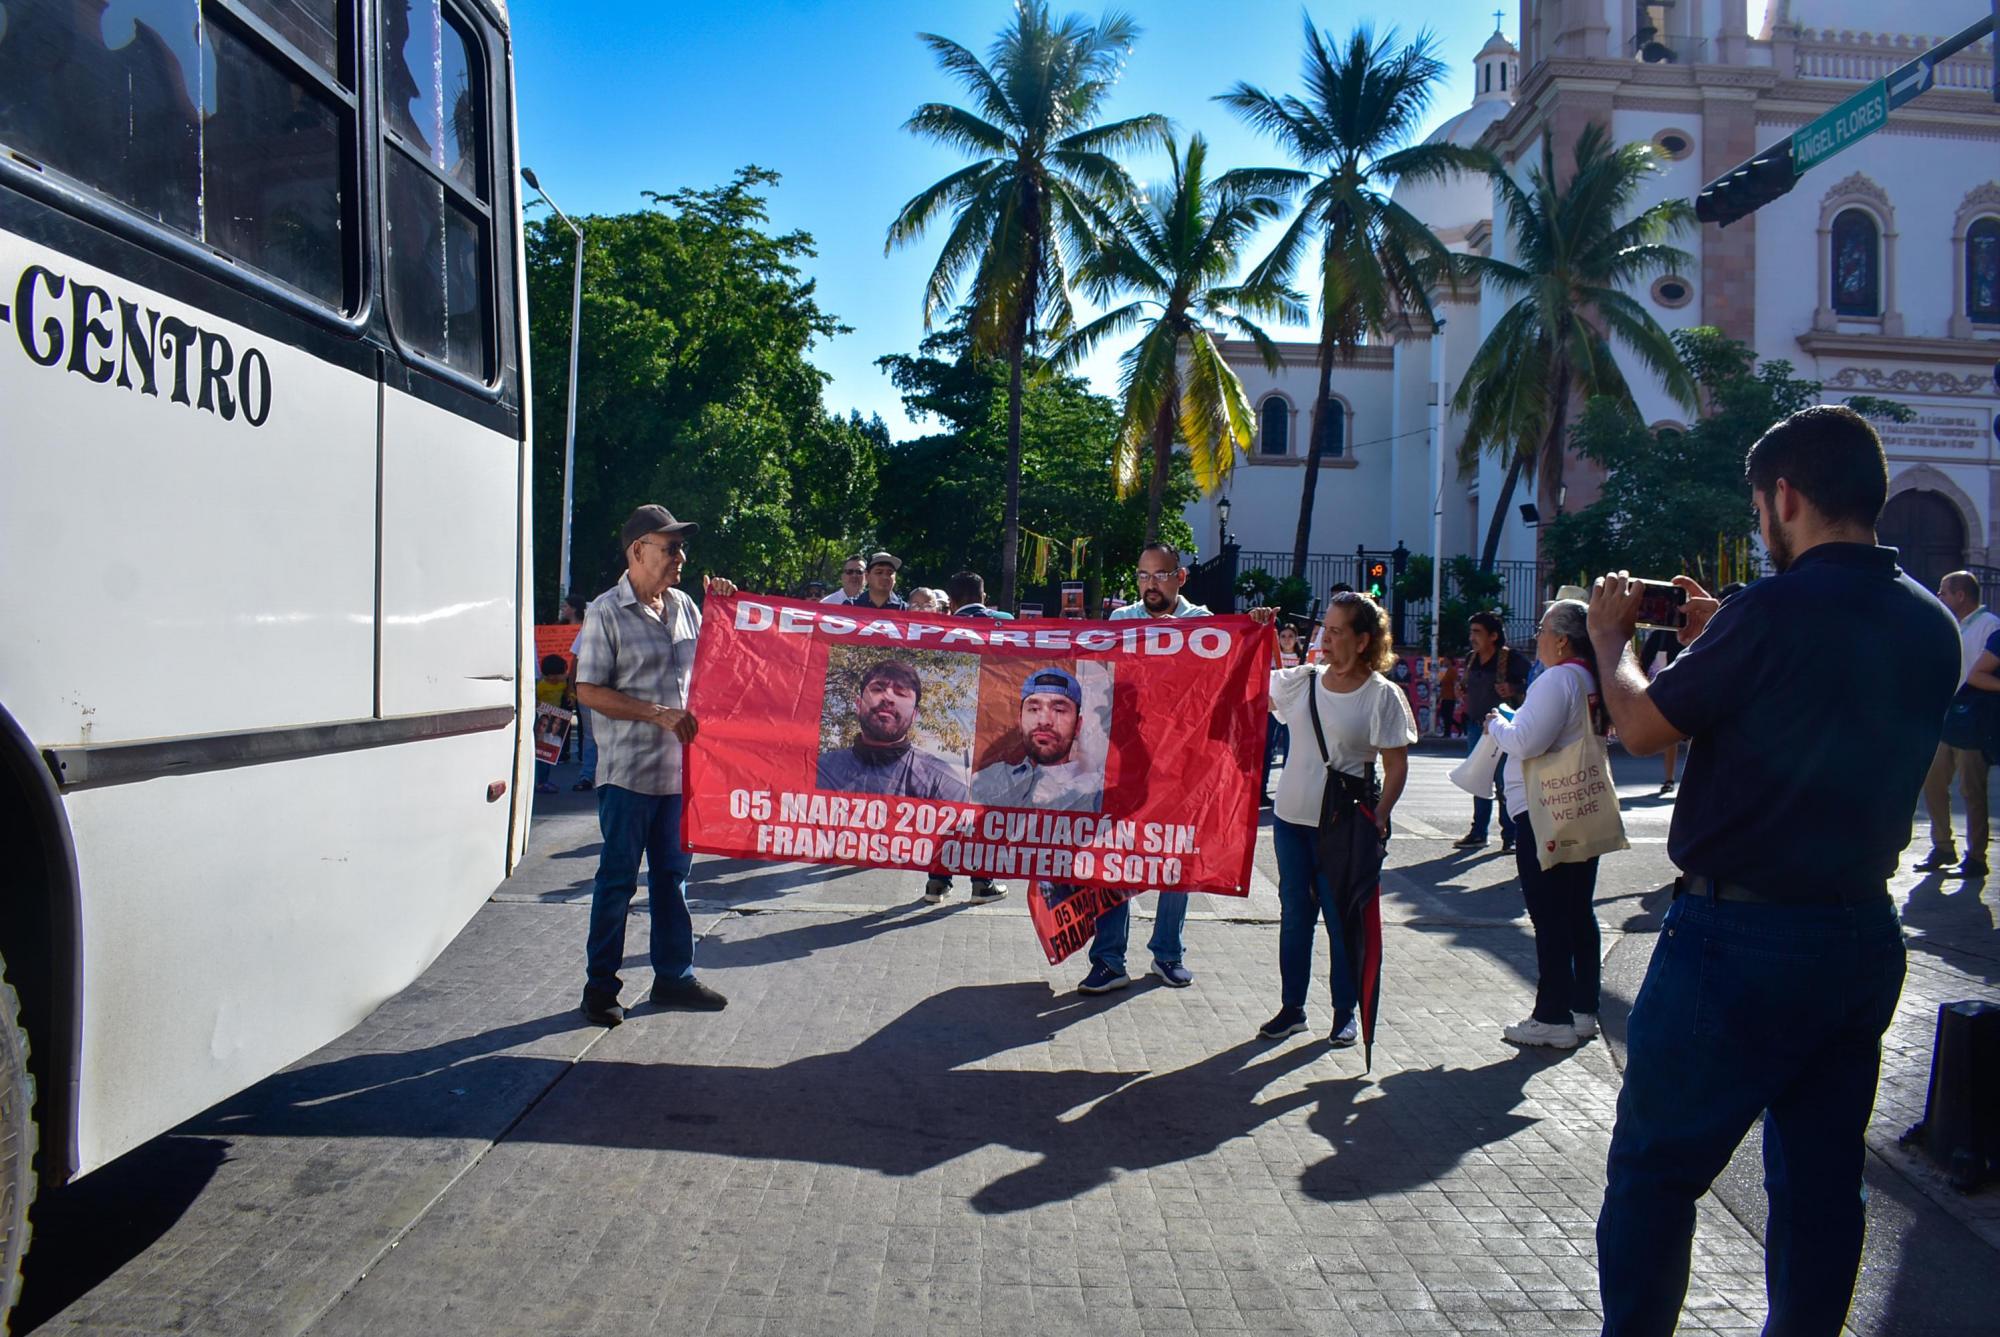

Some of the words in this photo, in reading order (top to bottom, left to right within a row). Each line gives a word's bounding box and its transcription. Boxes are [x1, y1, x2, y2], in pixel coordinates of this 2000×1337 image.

[1797, 127, 1835, 165] ANGEL
[1836, 96, 1883, 143] FLORES
[734, 600, 1232, 659] DESAPARECIDO
[1538, 780, 1607, 807] WHEREVER
[1541, 770, 1587, 790] MEXICO
[1589, 765, 1600, 777] IS
[729, 788, 772, 820] 05
[779, 792, 888, 830] MARZO
[895, 802, 976, 838] 2024
[983, 811, 1136, 850] CULIACÁN
[1143, 823, 1200, 855] SIN.
[1552, 808, 1574, 821] WE
[1577, 800, 1600, 819] ARE
[757, 824, 933, 866] FRANCISCO
[940, 840, 1095, 879] QUINTERO
[1102, 853, 1182, 886] SOTO
[1054, 902, 1072, 928] 05
